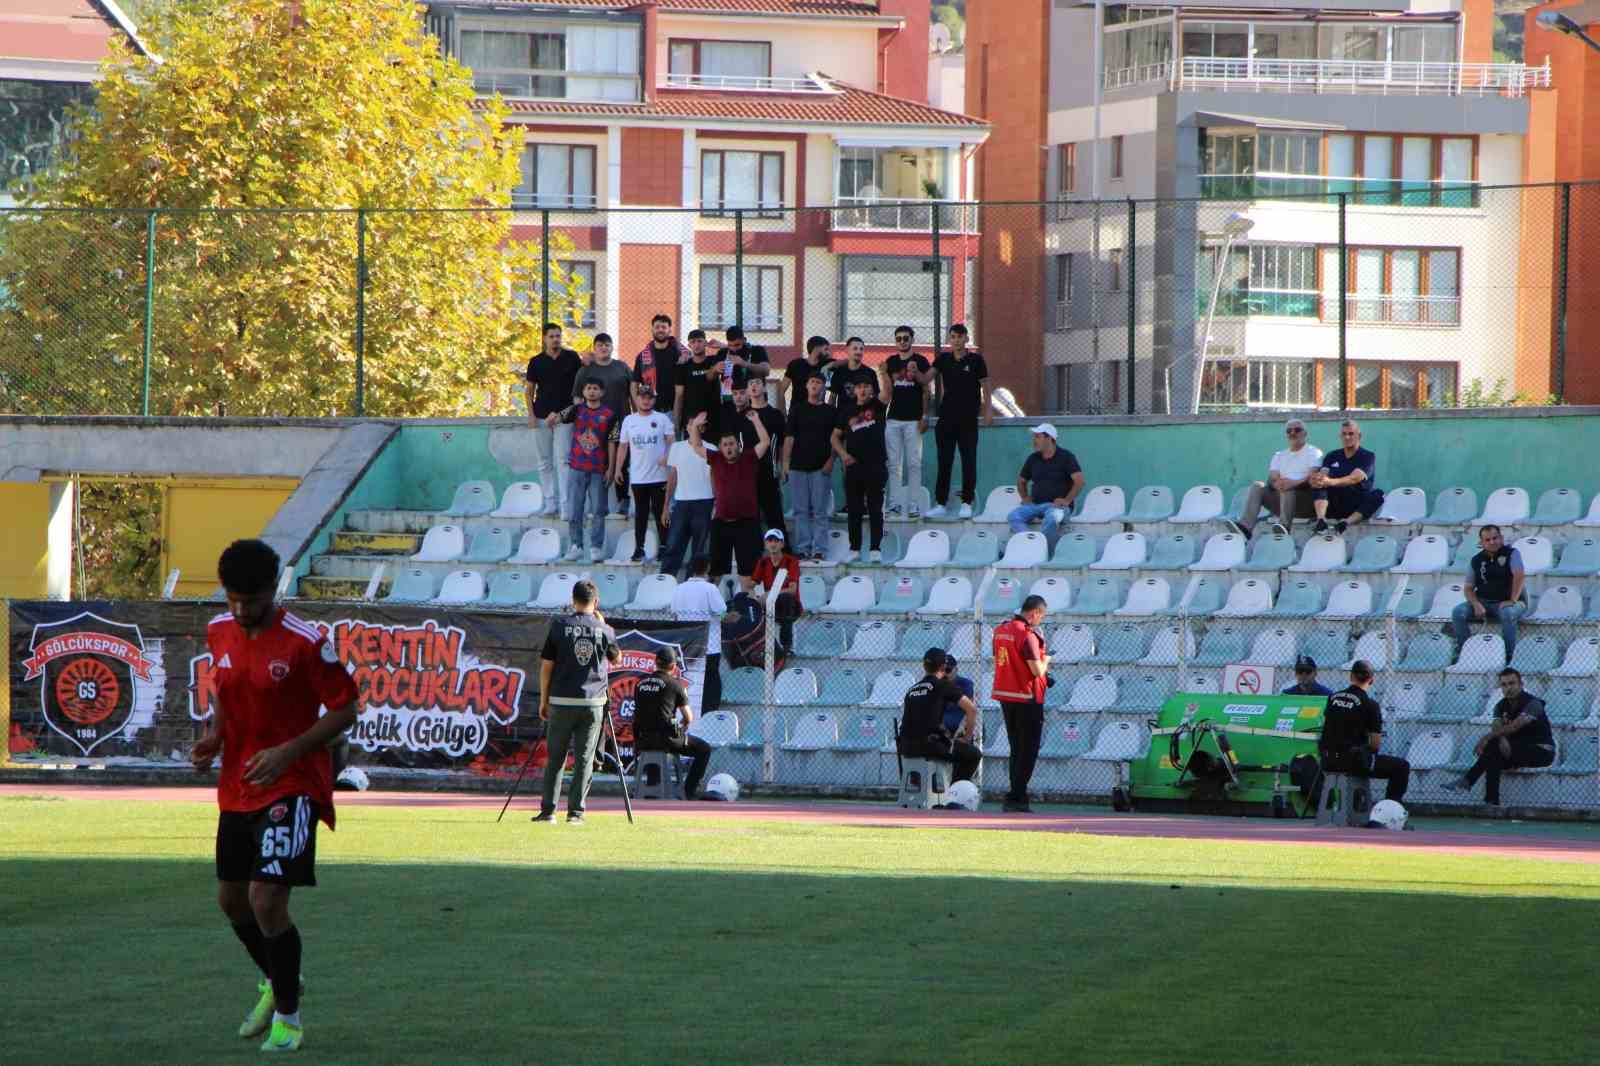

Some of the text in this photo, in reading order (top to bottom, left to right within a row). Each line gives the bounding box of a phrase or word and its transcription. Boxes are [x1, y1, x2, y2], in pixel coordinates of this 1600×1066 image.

[78, 681, 97, 699] GS
[354, 664, 519, 717] ÇOCUKLARI
[350, 713, 485, 752] nçlik (Gölge)
[262, 826, 290, 857] 65
